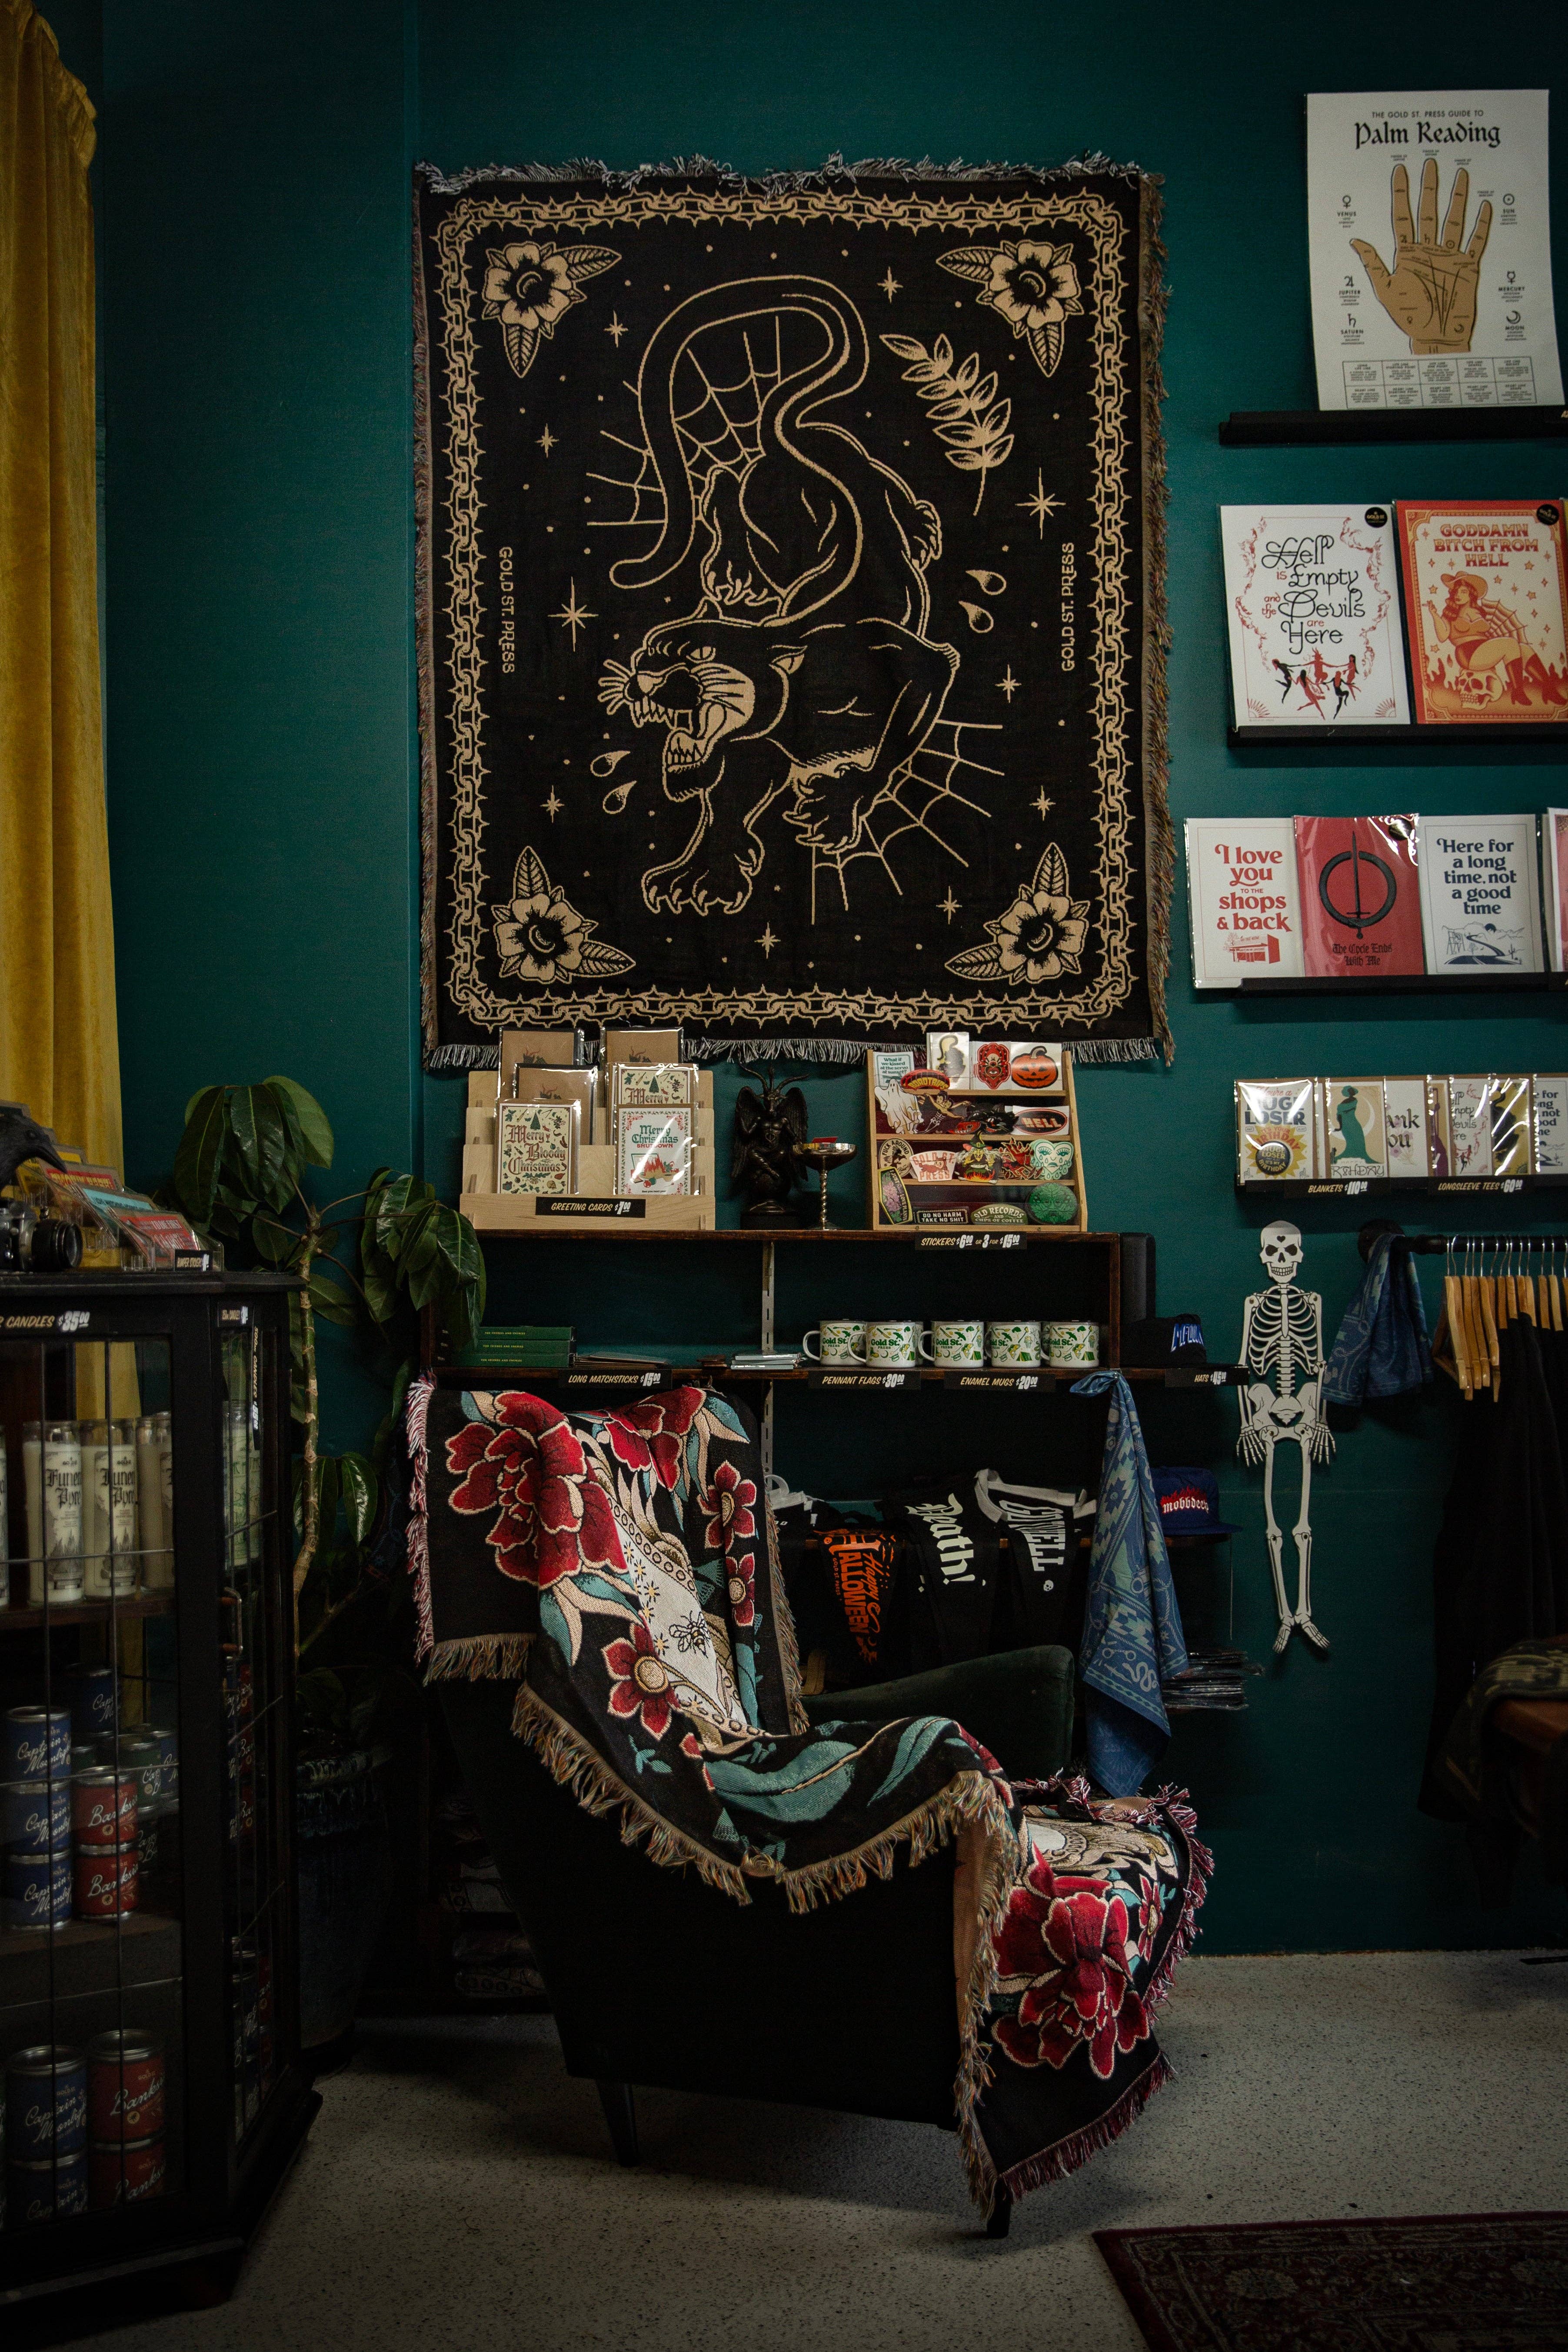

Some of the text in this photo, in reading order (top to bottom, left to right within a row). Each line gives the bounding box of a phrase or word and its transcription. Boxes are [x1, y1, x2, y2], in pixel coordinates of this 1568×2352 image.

[1372, 110, 1385, 119] THE
[1355, 121, 1501, 149] Palm Reading
[1440, 523, 1528, 537] GODDAMN
[1262, 535, 1334, 568] Hell
[1434, 539, 1539, 552] BITCH FROM
[1465, 553, 1509, 567] HELL
[1277, 564, 1358, 595] is Empty
[1264, 592, 1280, 602] and
[499, 547, 515, 673] GOLD ST. PRESS
[1062, 542, 1077, 671] GOLD ST. PRESS
[1262, 589, 1365, 623] the Devils
[1281, 621, 1343, 654] Here
[1437, 838, 1514, 853] Here for
[1215, 844, 1282, 864] I love
[1453, 855, 1506, 870] a long
[1229, 867, 1273, 886] you
[1488, 871, 1517, 884] not
[1452, 886, 1511, 902] a good
[1219, 892, 1286, 913] shops
[1464, 902, 1502, 915] time
[1217, 912, 1292, 932] & back
[1332, 943, 1392, 954] The Cycle Ends
[1344, 956, 1381, 966] With Me
[1542, 1090, 1558, 1098] for
[1245, 1111, 1306, 1125] LOSER
[1542, 1108, 1561, 1117] not
[1022, 1117, 1062, 1128] HELL
[506, 1125, 545, 1144] Merry
[639, 1125, 671, 1136] Mery
[632, 1134, 679, 1144] Chrismas
[524, 1143, 565, 1161] Bloody
[882, 1140, 909, 1155] FUCK AROUND
[508, 1157, 560, 1174] Christmas
[912, 1152, 937, 1166] GOLD
[919, 1169, 951, 1181] PRESS
[551, 1203, 587, 1211] GREETING
[974, 1207, 1025, 1219] OLD RECORDS
[921, 1238, 956, 1246] STICKERS
[982, 1234, 989, 1248] 3
[6, 1315, 56, 1328] CANDLES
[568, 1375, 587, 1384] LONG
[589, 1375, 639, 1384] MATCHSTICKS
[822, 1376, 857, 1385] PENNANT
[858, 1376, 882, 1385] FLAGS
[960, 1377, 990, 1386] ENAMEL
[991, 1377, 1015, 1387] MUGS
[905, 1493, 975, 1585] Death!
[860, 1552, 885, 1601] Happy
